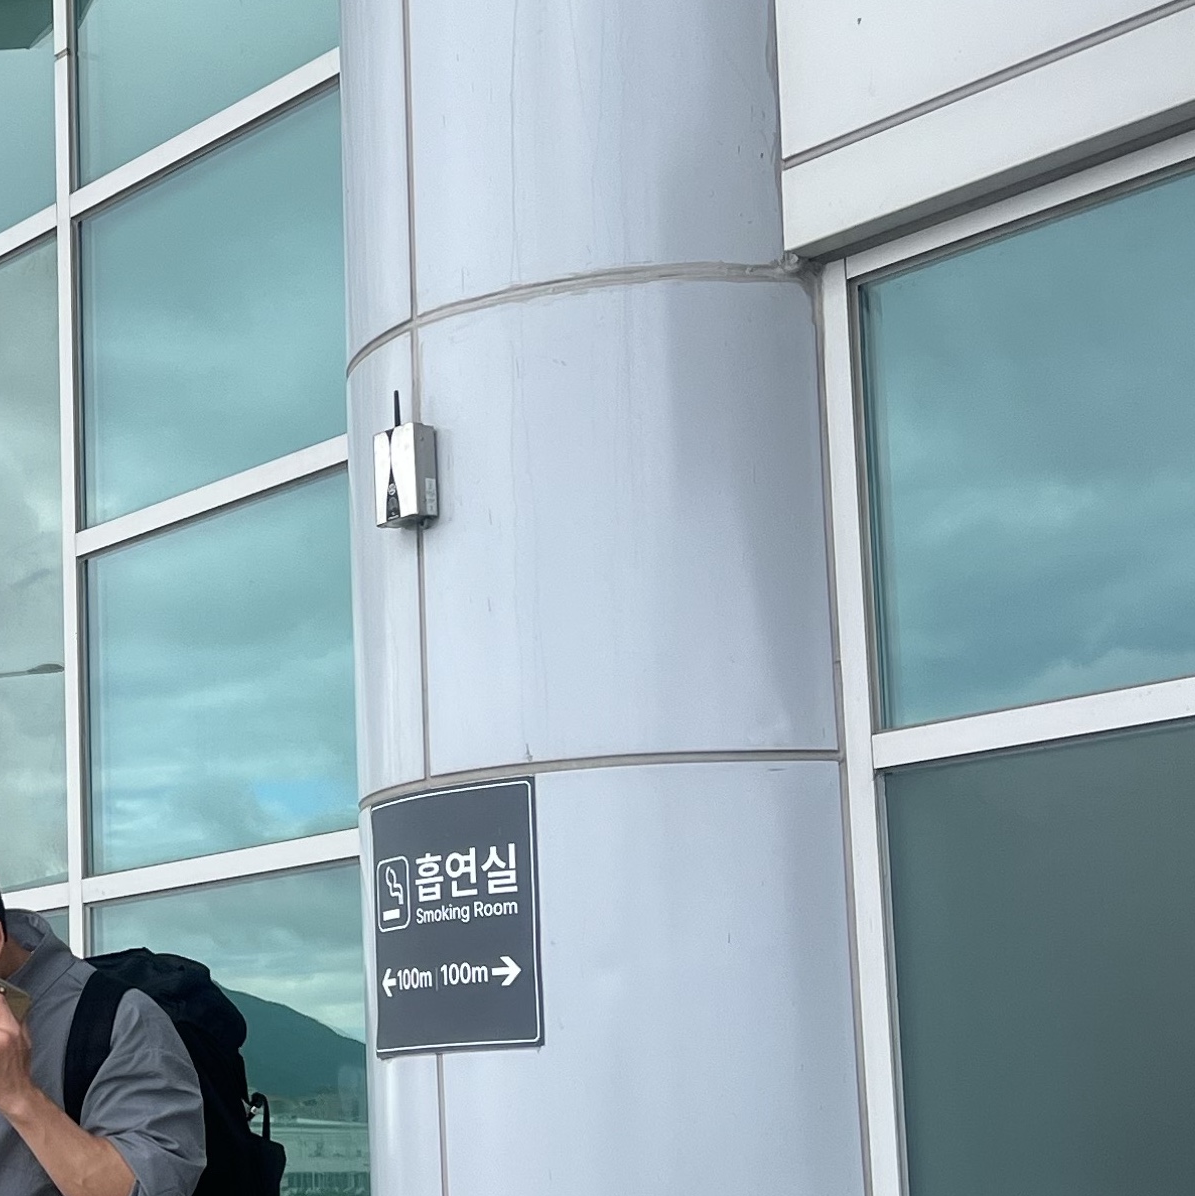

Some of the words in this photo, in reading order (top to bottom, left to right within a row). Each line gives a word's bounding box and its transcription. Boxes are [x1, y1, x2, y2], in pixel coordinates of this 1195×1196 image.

[415, 843, 518, 903] 흡연실
[416, 904, 470, 924] Smoking
[474, 901, 518, 917] Room
[397, 967, 433, 990] 100m
[440, 963, 489, 985] 100m
